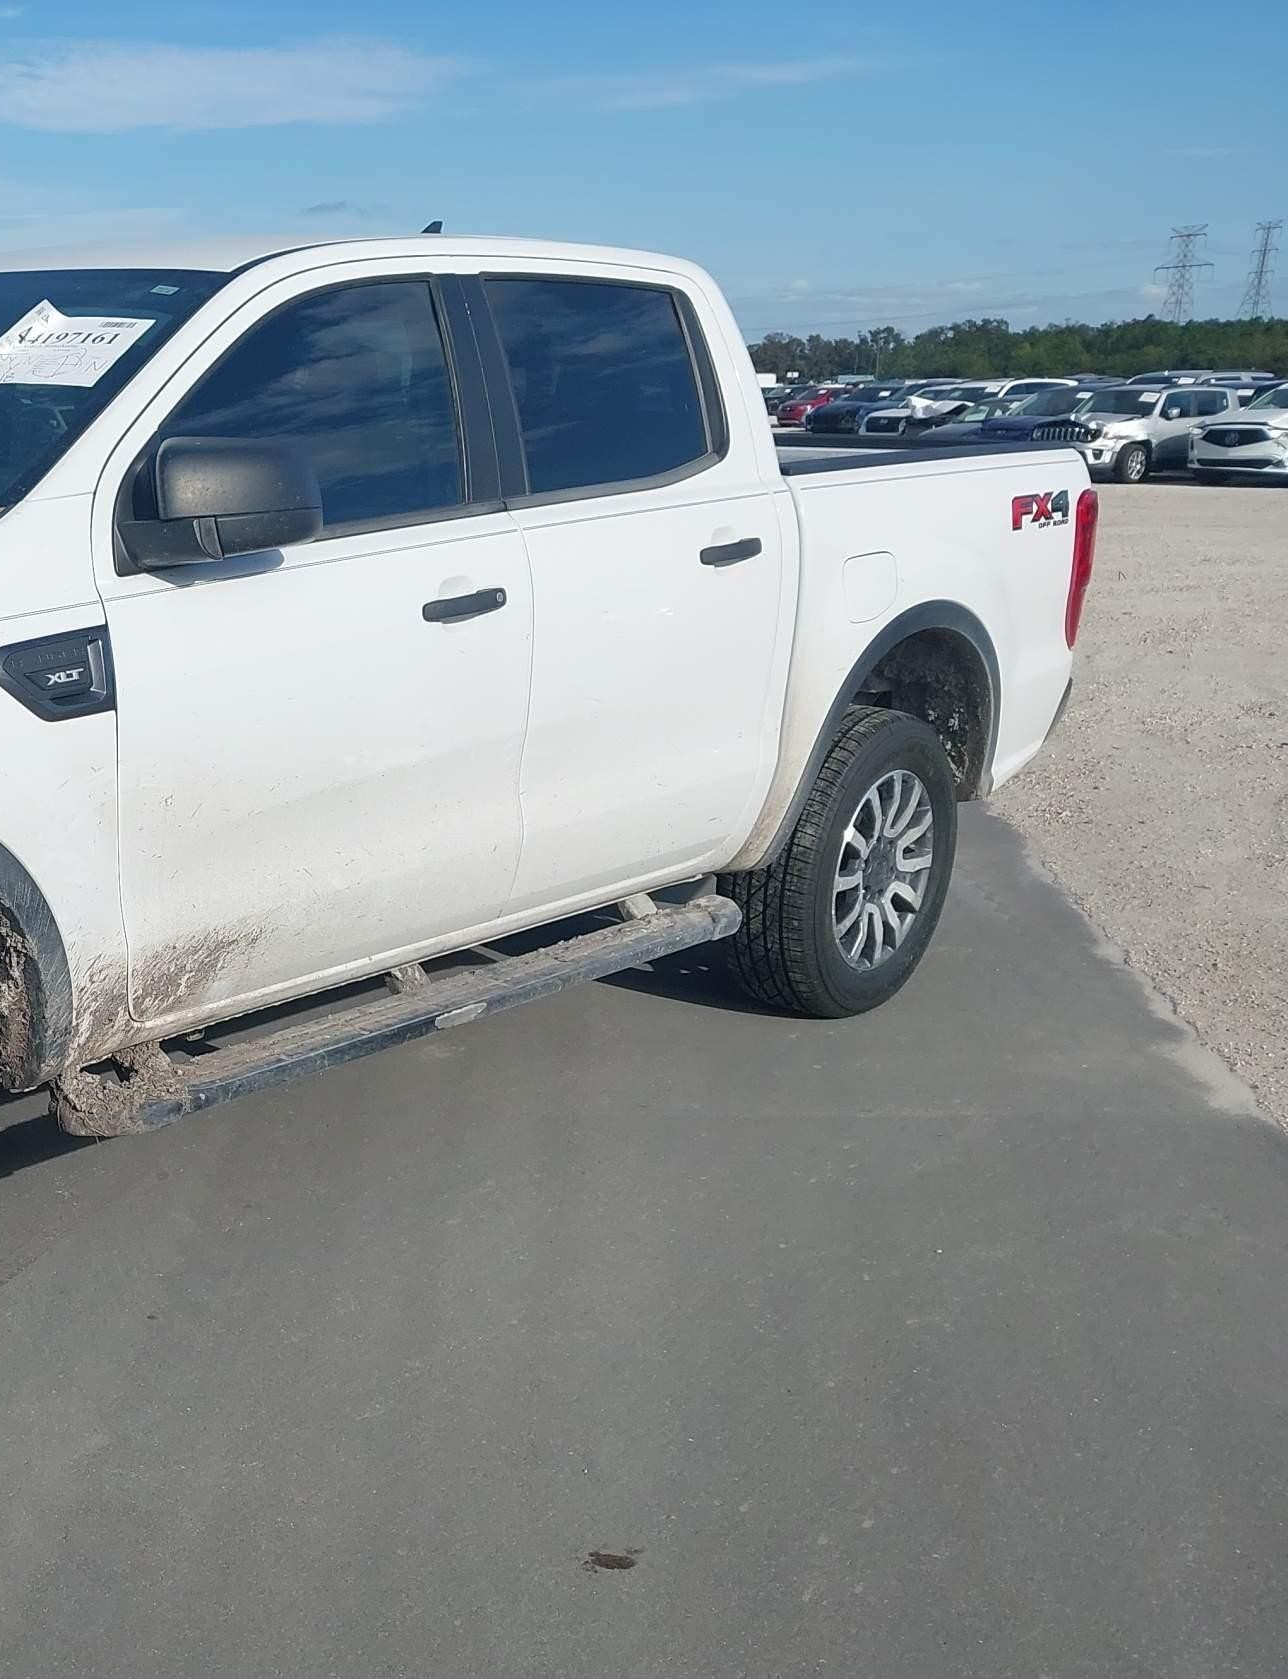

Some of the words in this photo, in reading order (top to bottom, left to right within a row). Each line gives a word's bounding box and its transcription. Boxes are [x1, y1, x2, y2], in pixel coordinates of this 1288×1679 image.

[1011, 489, 1069, 531] FX4
[1053, 518, 1069, 527] ROAD
[45, 668, 84, 686] XLT
